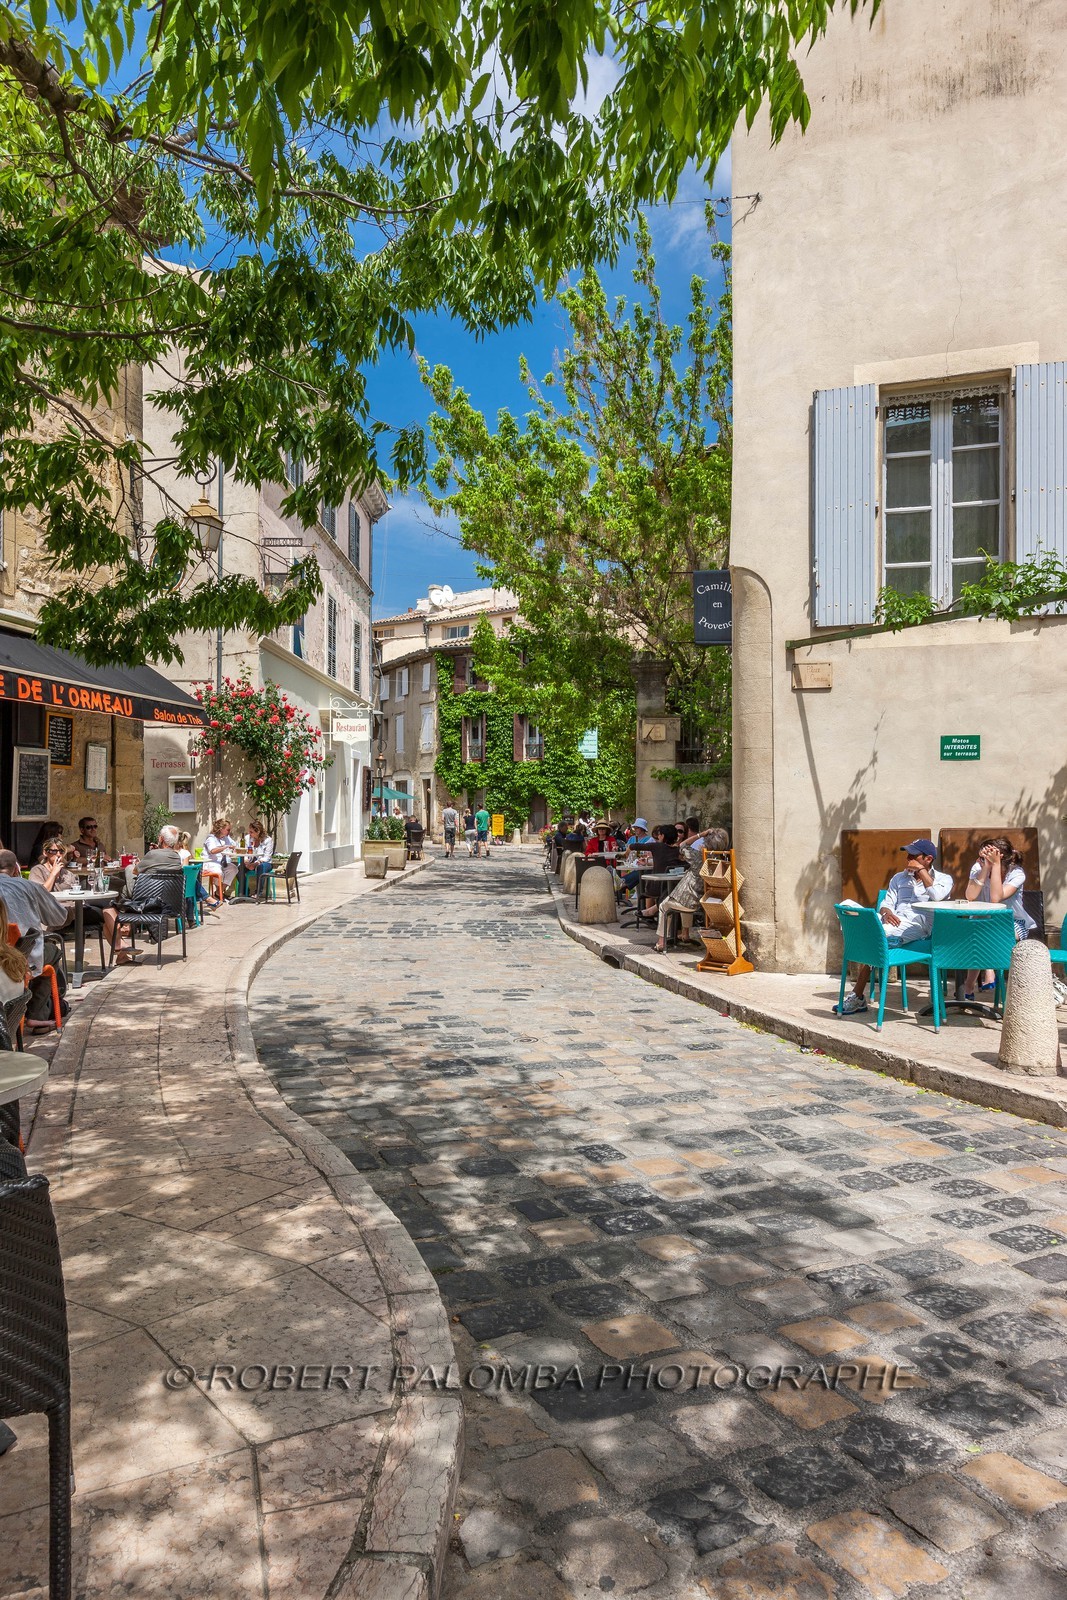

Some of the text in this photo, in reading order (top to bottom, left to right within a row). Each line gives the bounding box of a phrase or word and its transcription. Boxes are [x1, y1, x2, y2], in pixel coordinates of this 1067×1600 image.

[697, 616, 733, 630] Provenc
[17, 677, 43, 702] DE
[51, 683, 133, 717] L'ORMEAU
[153, 707, 176, 723] Salon
[176, 712, 188, 724] de
[150, 758, 186, 769] Terrasse
